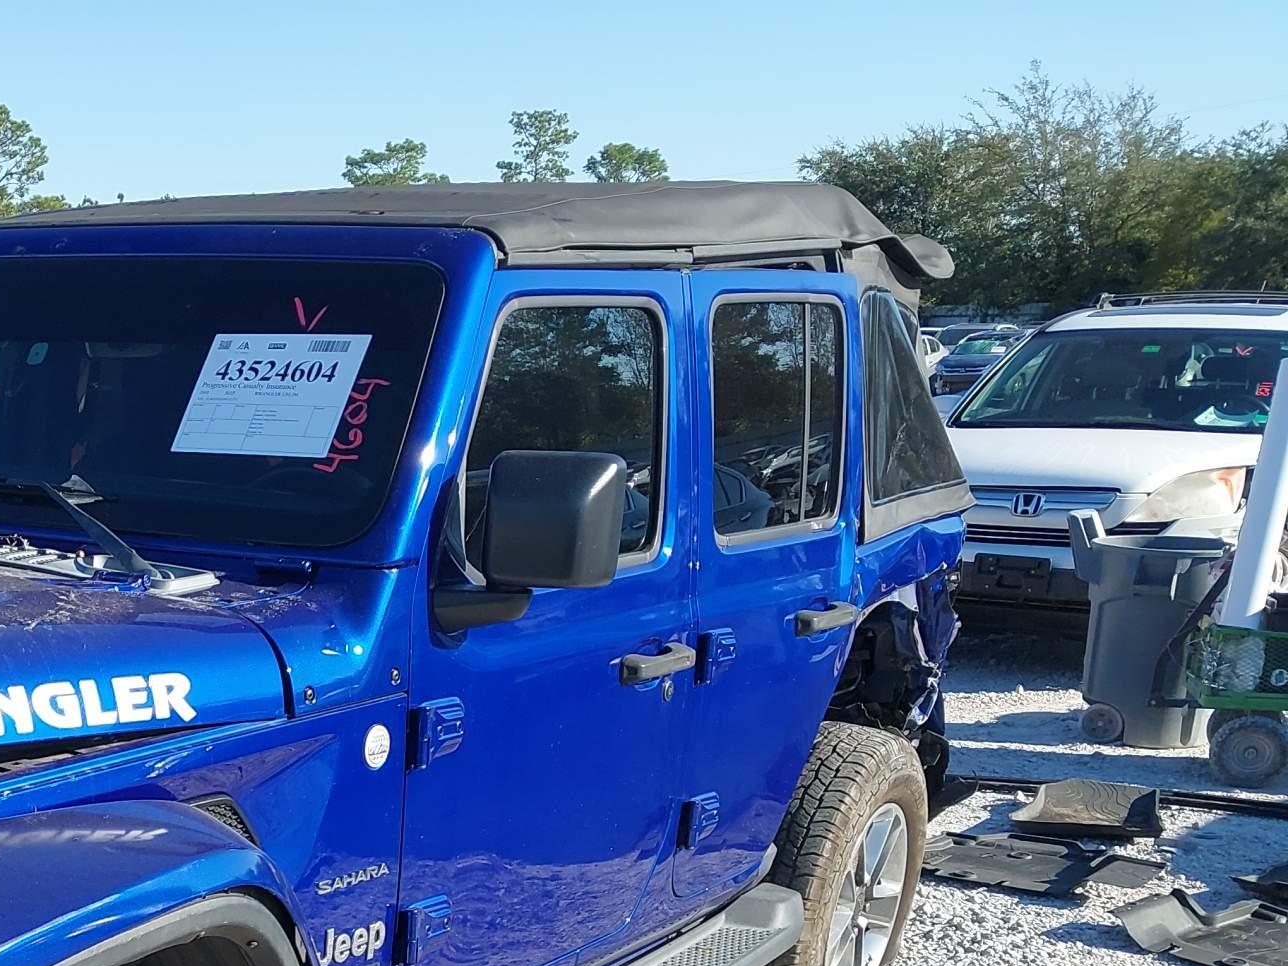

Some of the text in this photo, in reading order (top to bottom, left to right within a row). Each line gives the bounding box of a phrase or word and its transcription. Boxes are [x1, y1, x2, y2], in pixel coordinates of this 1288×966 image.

[216, 359, 340, 383] 43524604
[313, 378, 391, 473] 4604
[316, 863, 390, 896] SAHARA
